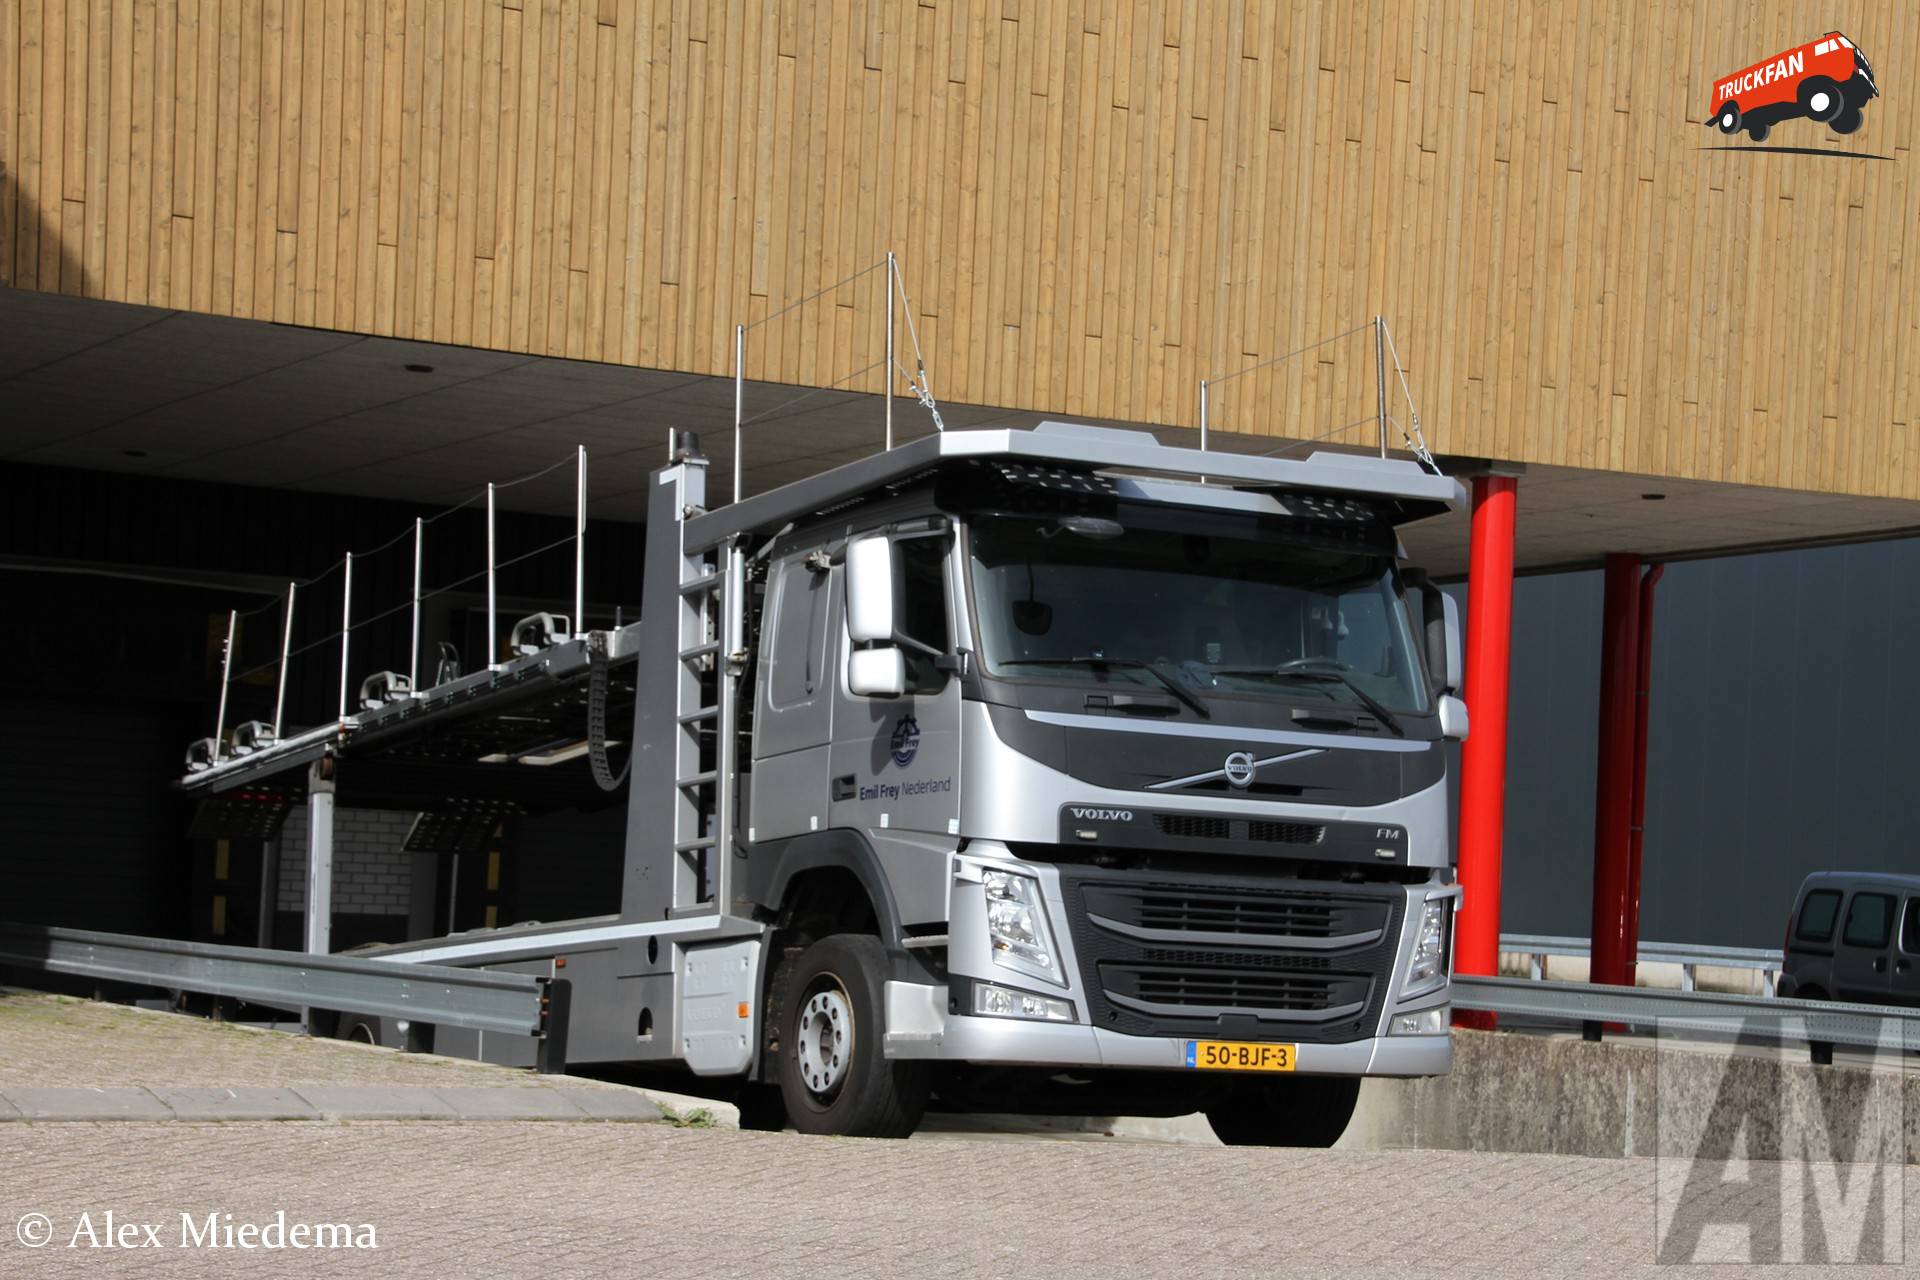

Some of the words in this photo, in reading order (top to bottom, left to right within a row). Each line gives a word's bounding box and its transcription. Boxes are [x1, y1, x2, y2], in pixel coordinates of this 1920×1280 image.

[860, 784, 879, 801] Emil
[880, 784, 900, 801] Frey
[901, 776, 951, 796] Nederland
[1070, 807, 1133, 822] VOLVO
[1376, 828, 1399, 839] FM
[1205, 1045, 1287, 1067] 50-BJF-3
